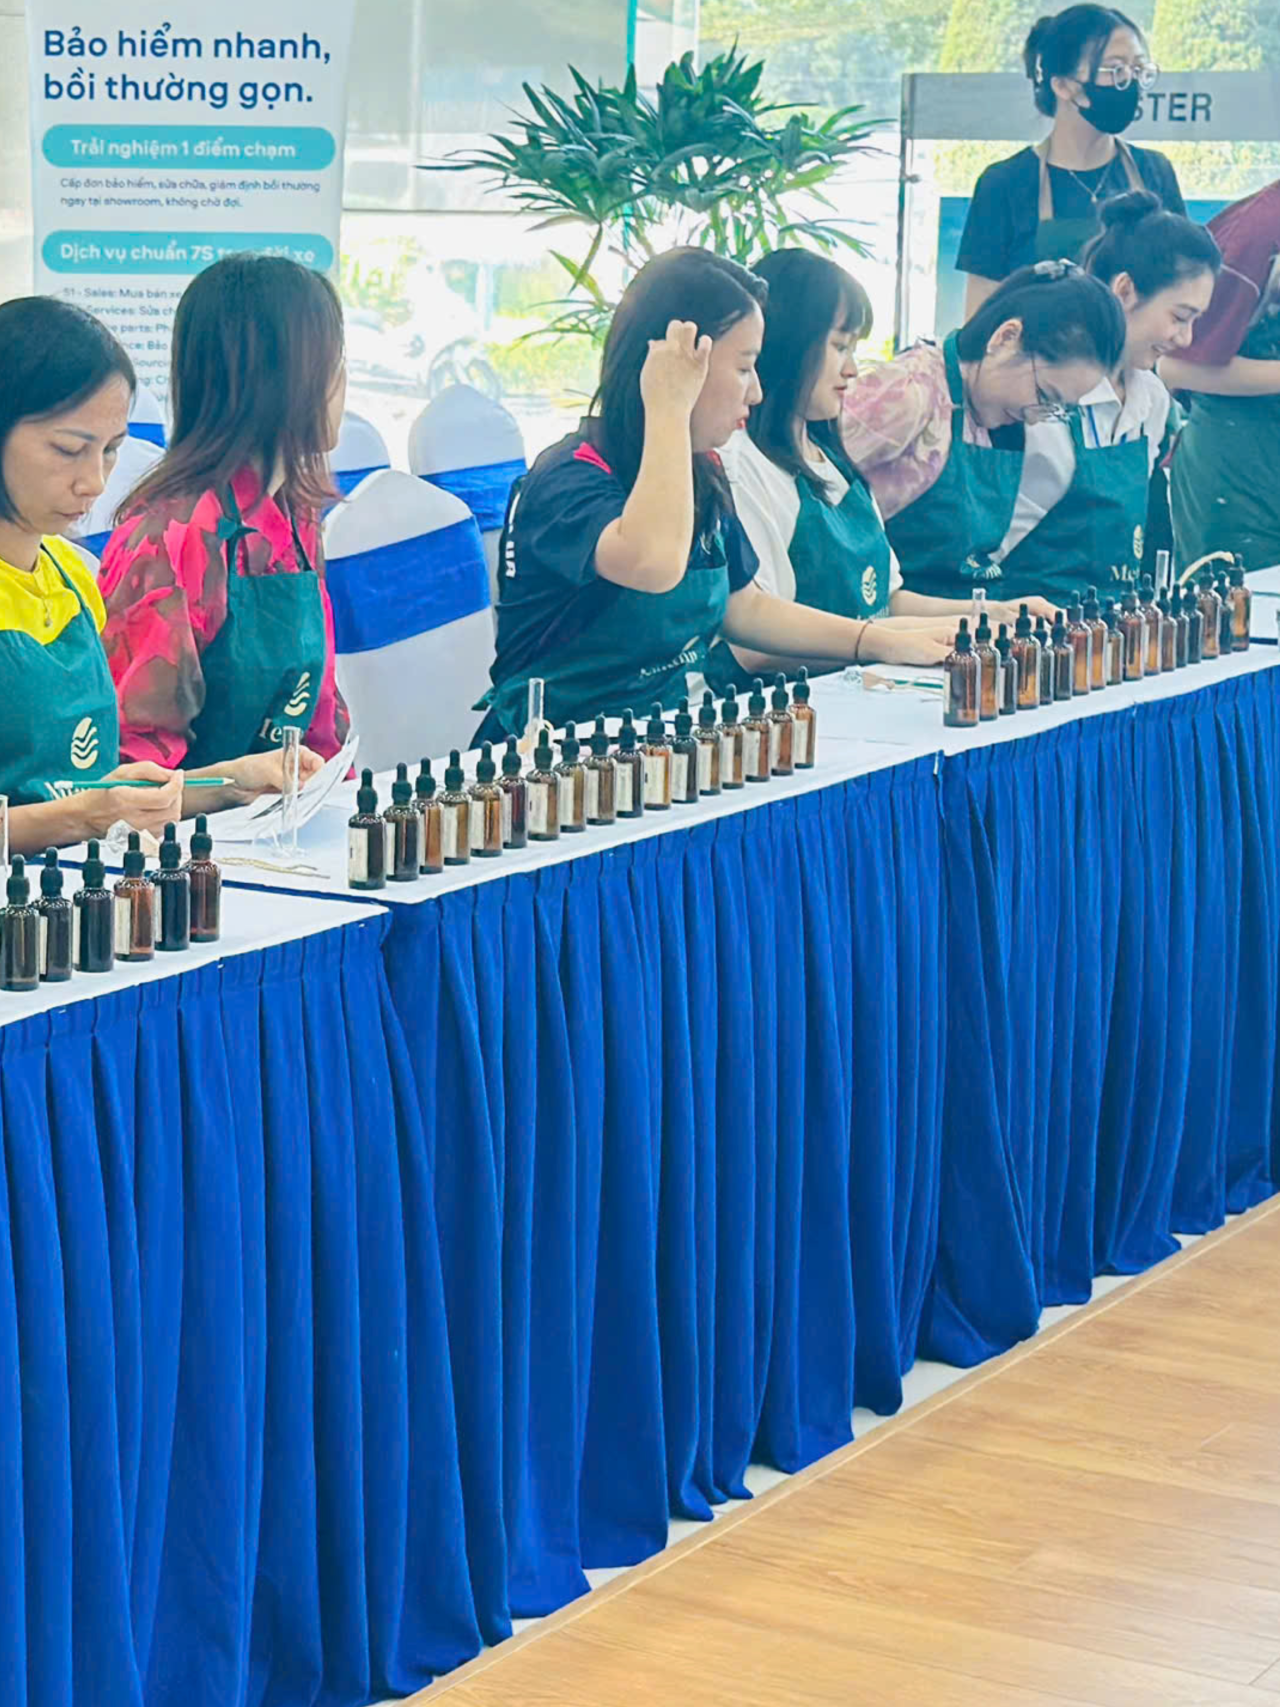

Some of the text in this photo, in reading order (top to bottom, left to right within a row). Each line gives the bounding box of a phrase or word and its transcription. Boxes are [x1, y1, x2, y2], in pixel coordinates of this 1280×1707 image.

[43, 22, 330, 64] Bảo hiểm nhanh,
[44, 67, 313, 110] bồi thường gọn.
[71, 136, 296, 161] Trải nghiệm 1 điểm chạm
[105, 177, 125, 189] bảo
[60, 198, 85, 209] ngay
[104, 197, 163, 208] showroom,
[166, 197, 198, 209] không
[60, 243, 101, 263] Dịch
[104, 247, 127, 263] vụ
[130, 240, 187, 260] chuẩn
[191, 246, 214, 261] 7S
